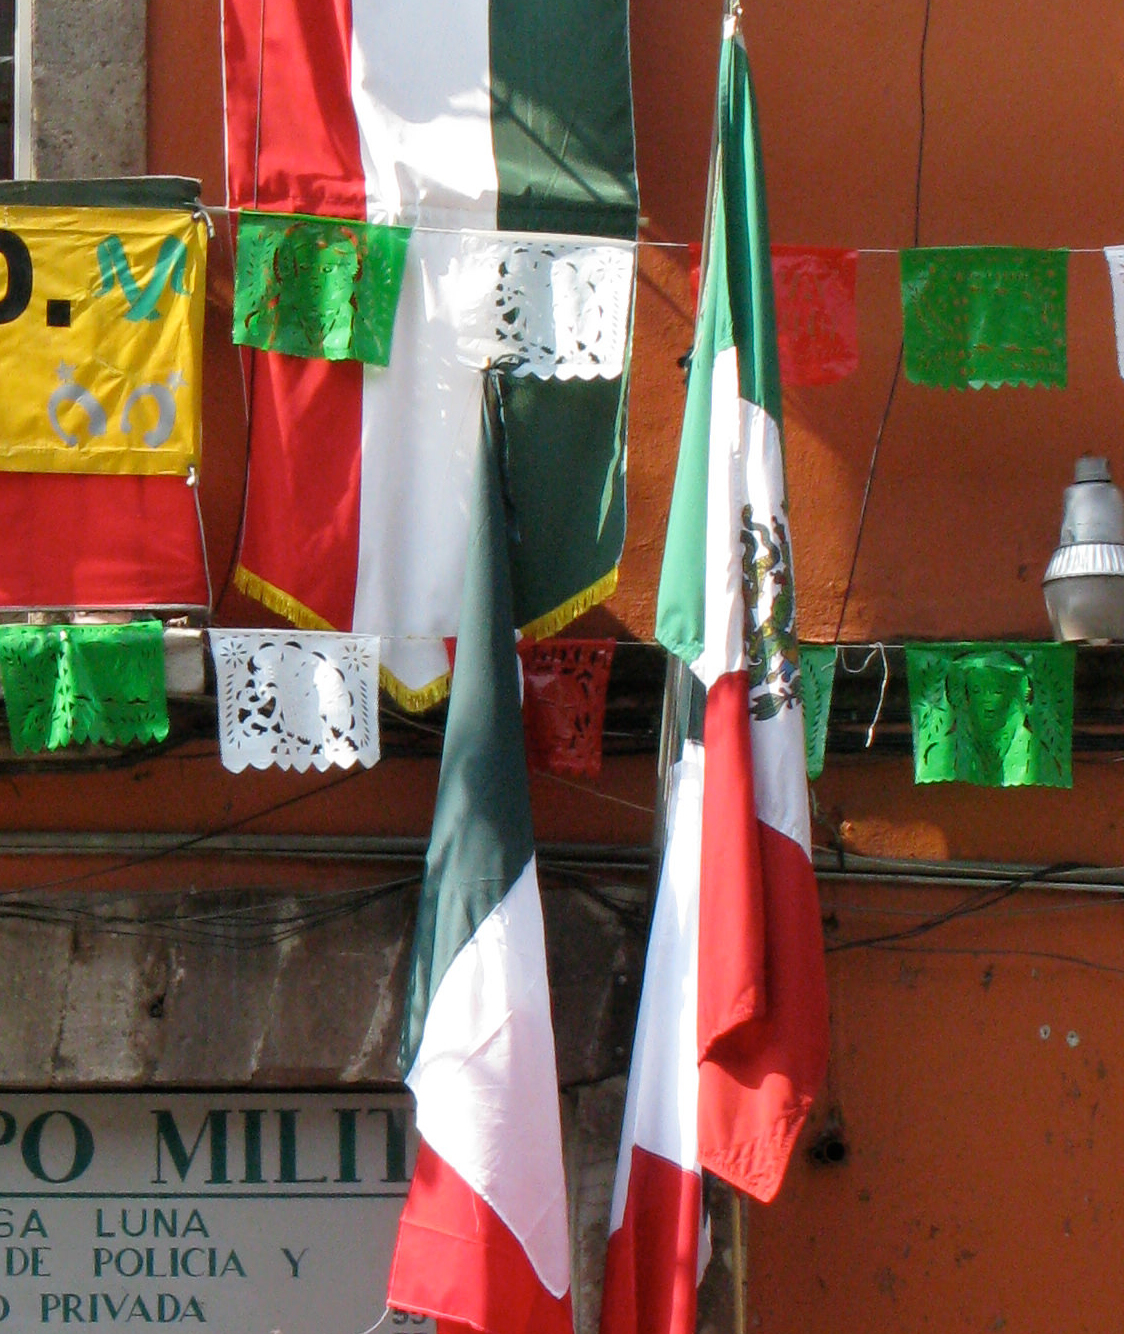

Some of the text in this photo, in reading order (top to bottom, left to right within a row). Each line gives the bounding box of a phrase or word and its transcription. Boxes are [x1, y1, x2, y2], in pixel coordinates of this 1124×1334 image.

[95, 1208, 210, 1238] LUNA
[5, 1247, 52, 1277] DE
[92, 1247, 247, 1278] POLICIA
[281, 1247, 310, 1278] Y
[41, 1293, 208, 1324] PRIVADA
